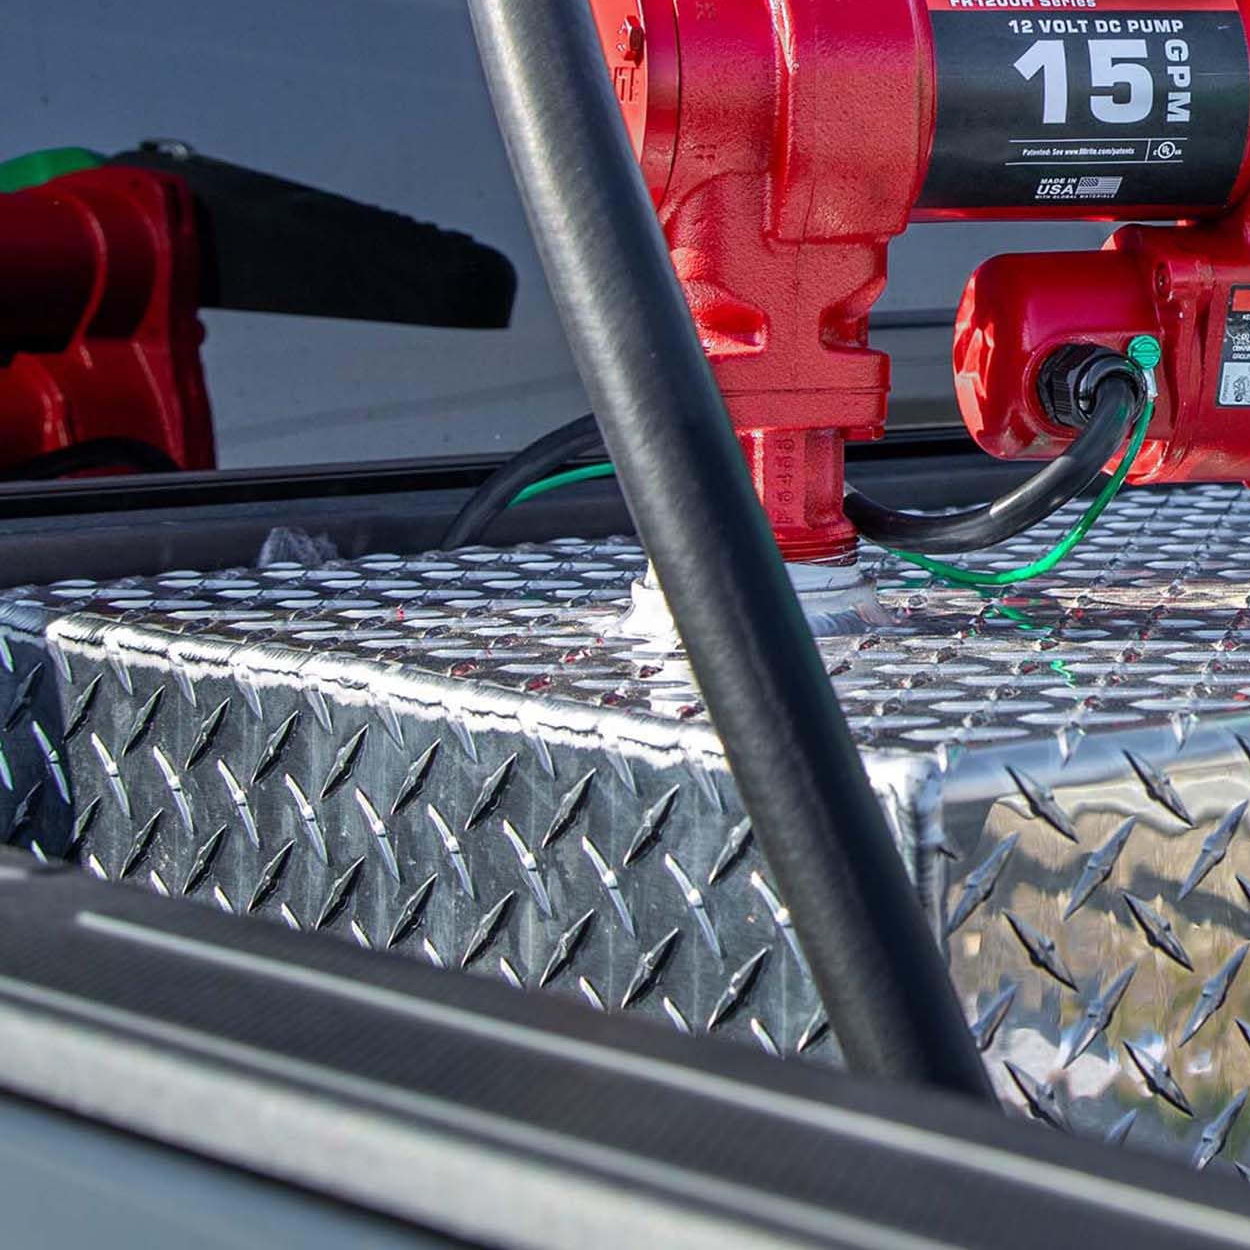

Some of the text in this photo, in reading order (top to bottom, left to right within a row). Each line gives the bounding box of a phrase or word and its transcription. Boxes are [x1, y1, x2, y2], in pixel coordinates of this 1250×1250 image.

[1008, 19, 1184, 34] 12 VOLT DC PUMP
[1013, 38, 1154, 125] 15
[1166, 39, 1192, 123] GPM
[1036, 184, 1074, 195] USA
